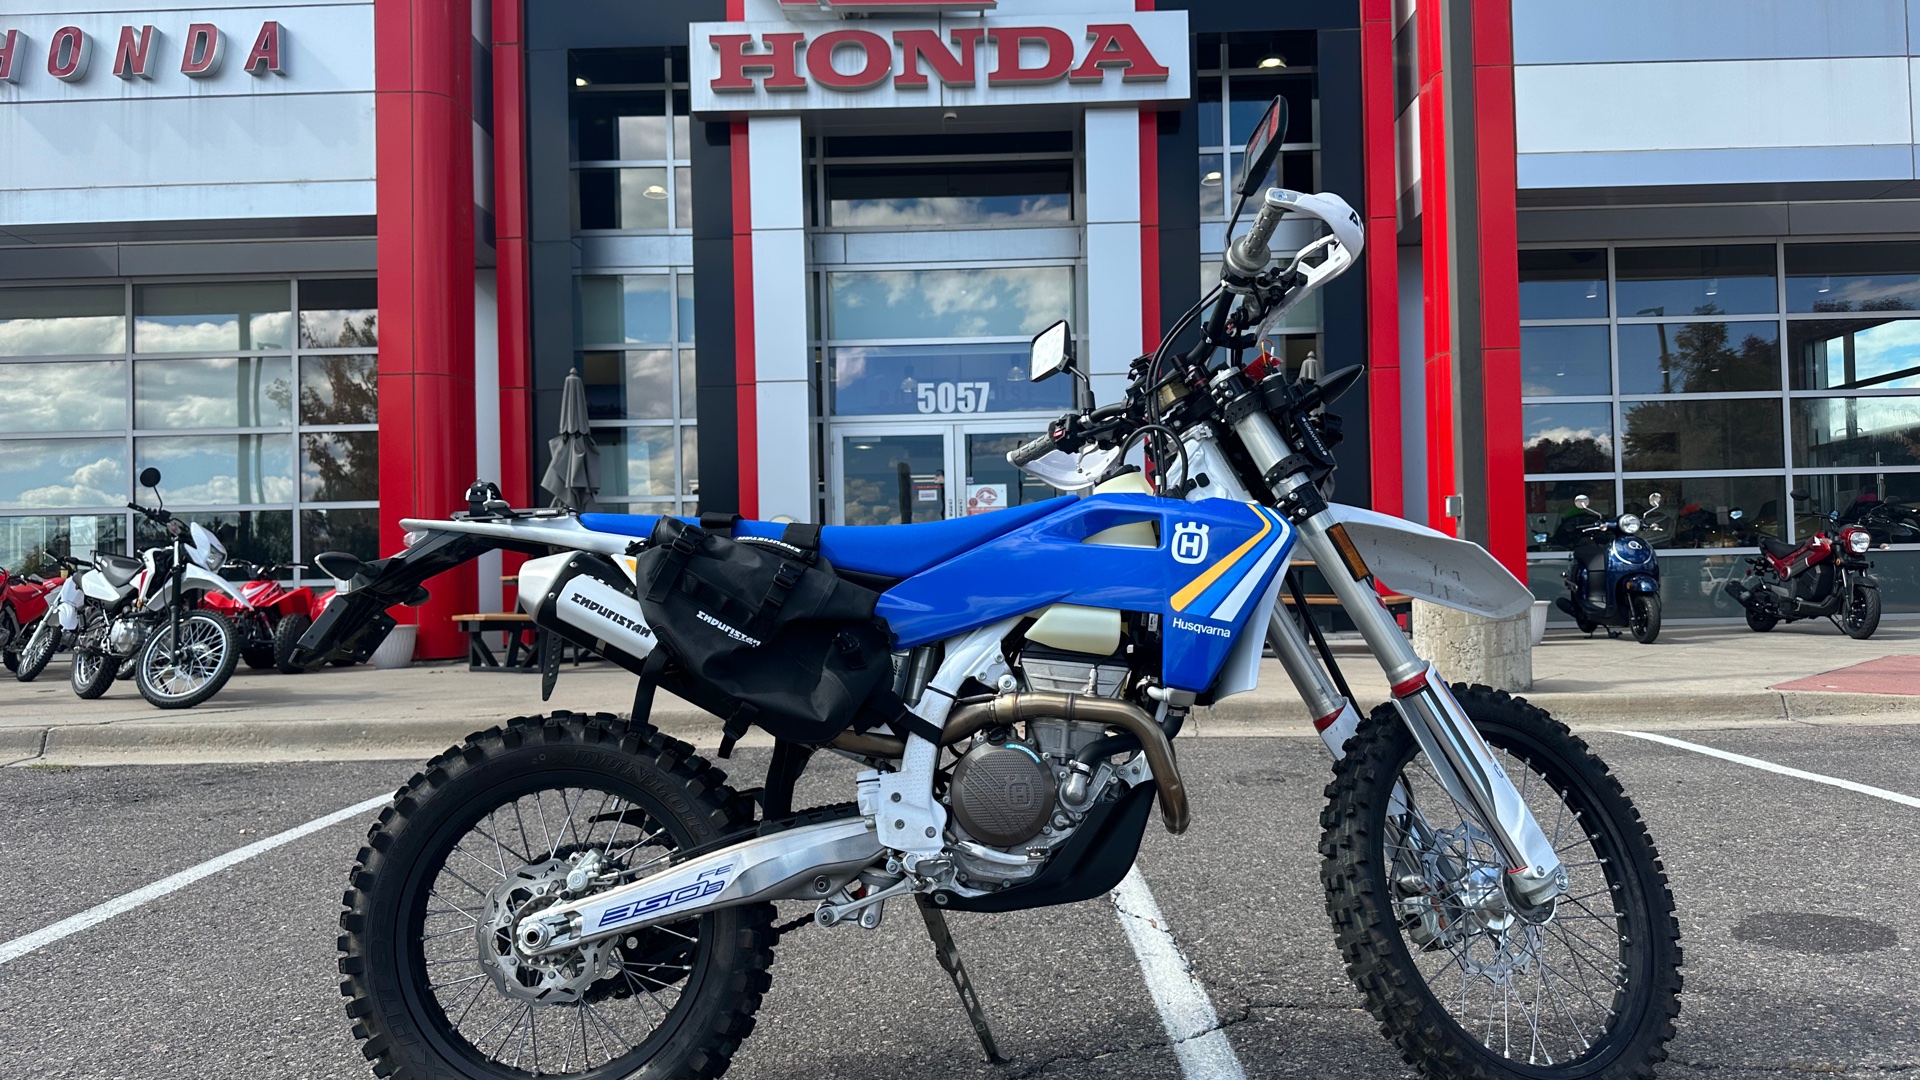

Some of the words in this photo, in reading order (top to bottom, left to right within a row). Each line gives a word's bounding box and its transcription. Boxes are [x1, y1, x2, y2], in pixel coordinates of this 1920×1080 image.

[708, 23, 1170, 94] HONDA
[917, 381, 990, 414] 5057
[1303, 422, 1325, 452] GRAVITAS
[1172, 617, 1231, 638] Husqvarna
[571, 749, 711, 839] DUNLOP
[696, 863, 734, 882] FE
